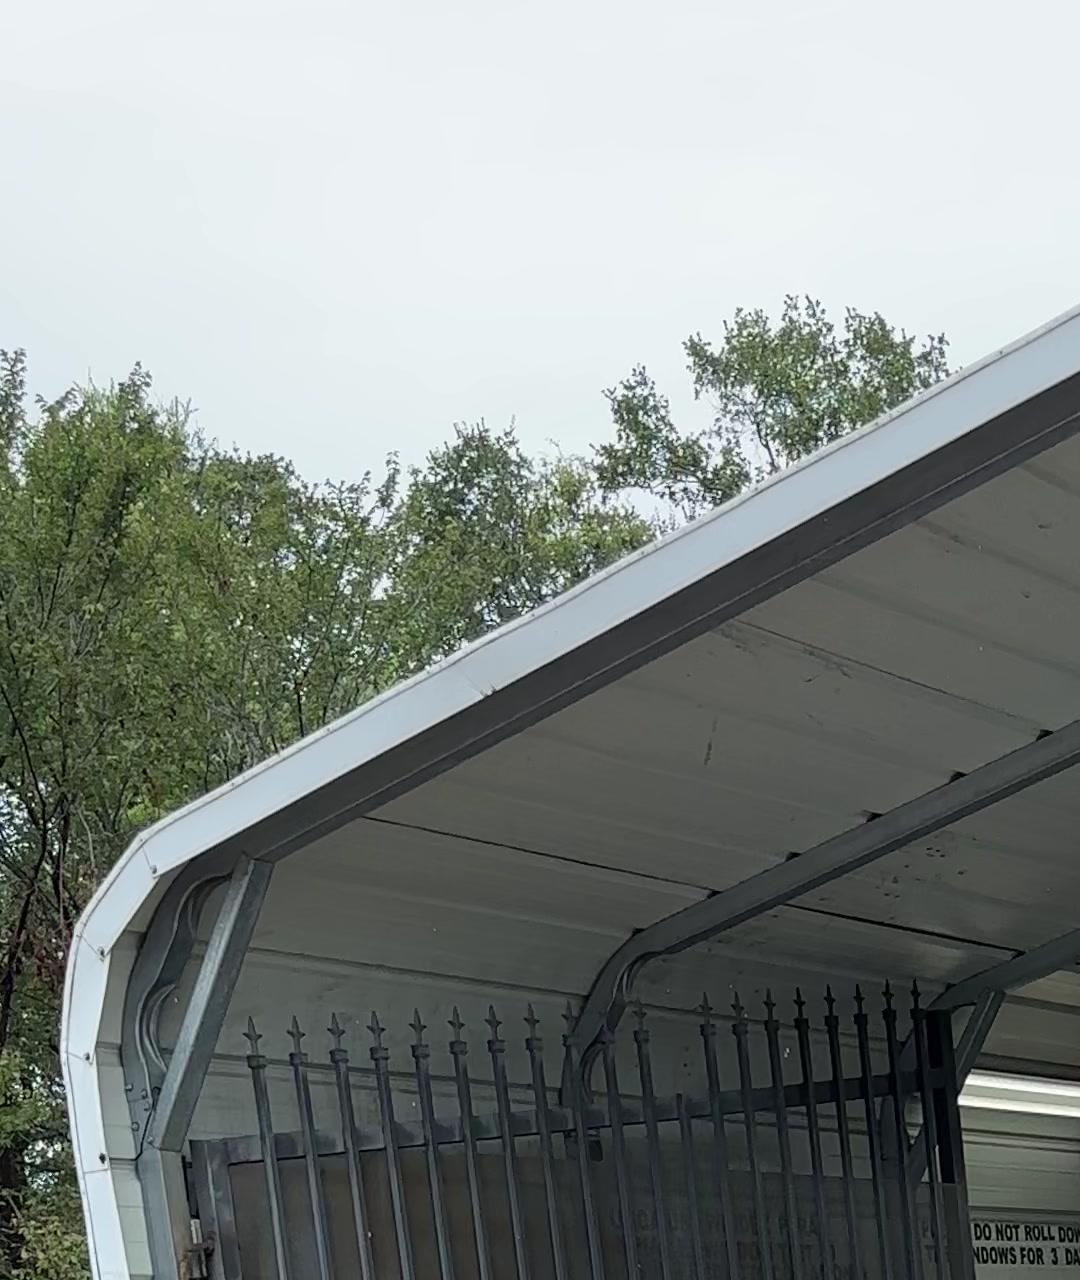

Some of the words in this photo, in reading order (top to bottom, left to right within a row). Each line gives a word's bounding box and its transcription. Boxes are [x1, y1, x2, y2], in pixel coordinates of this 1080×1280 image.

[974, 1223, 992, 1241] DO
[996, 1224, 1020, 1242] NOT
[1024, 1225, 1055, 1242] ROLL
[1021, 1247, 1044, 1265] FOR
[1051, 1248, 1059, 1266] 3
